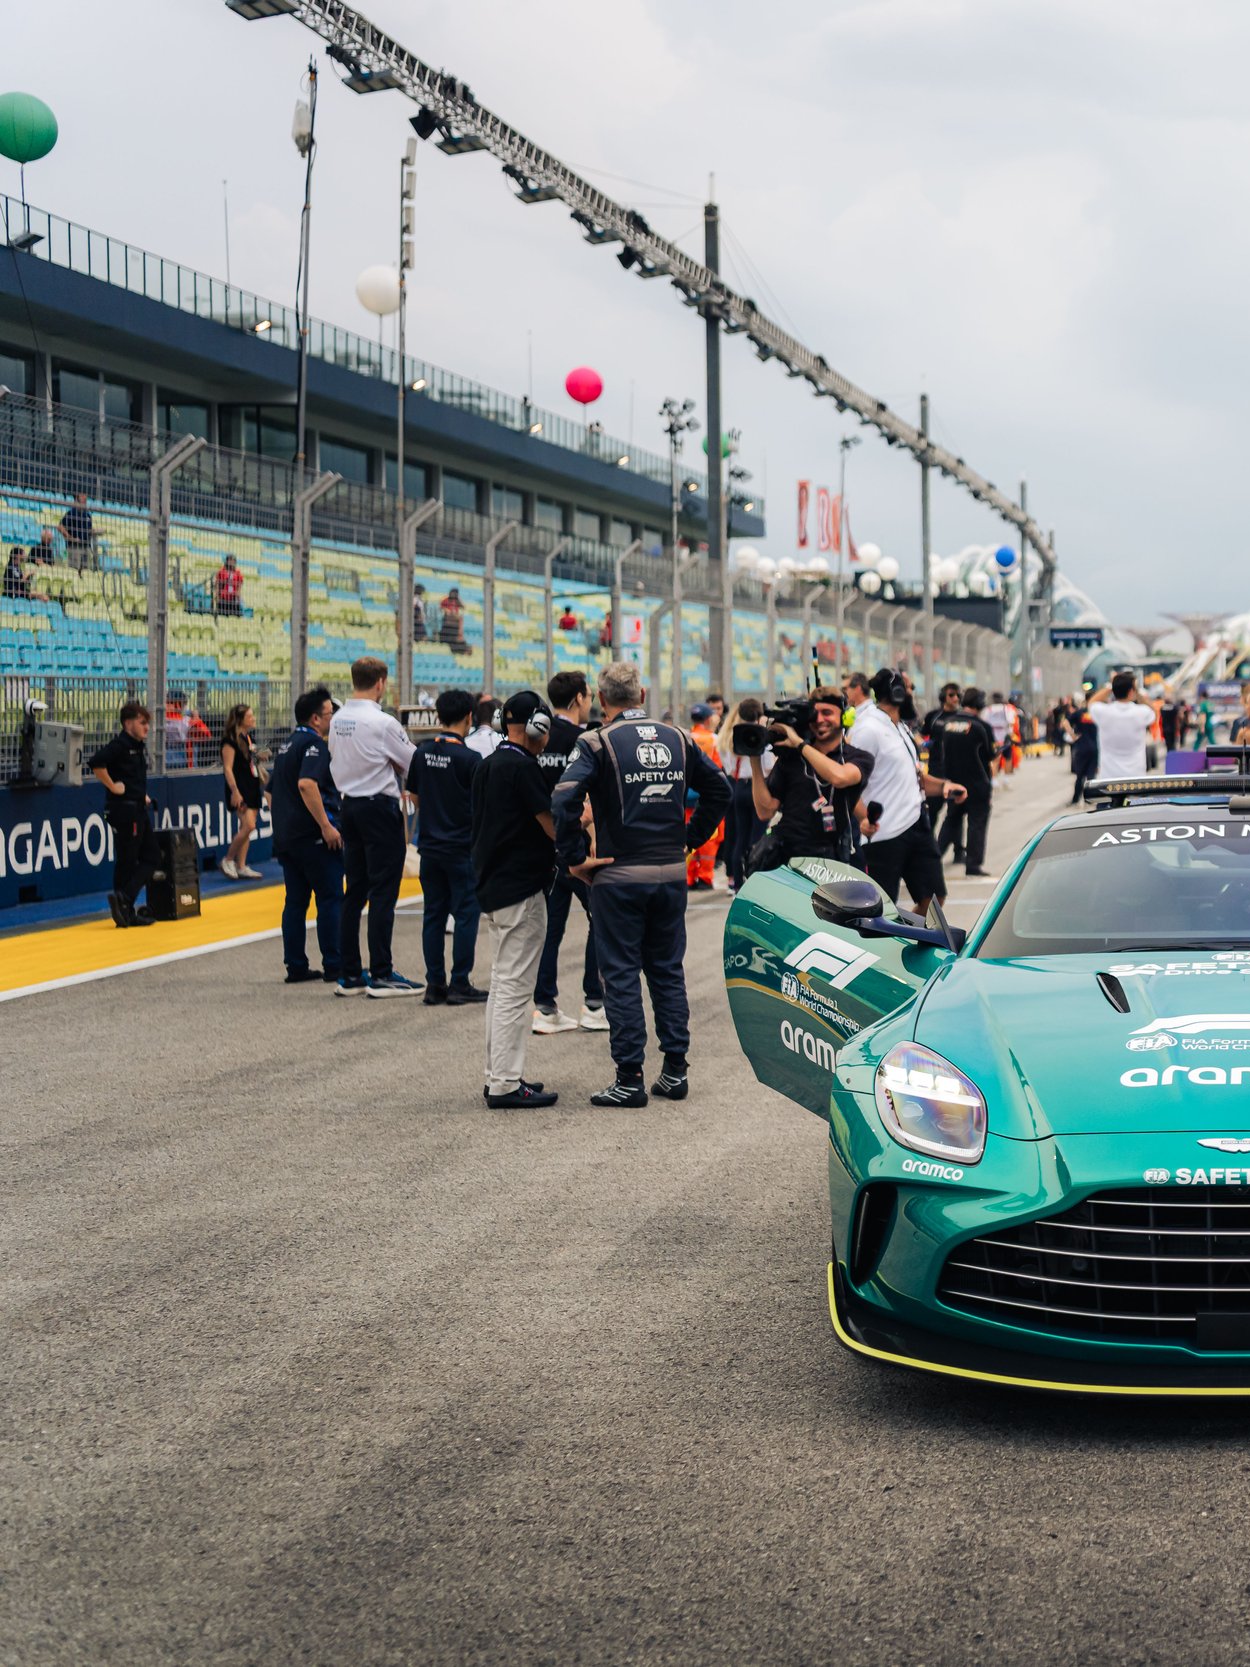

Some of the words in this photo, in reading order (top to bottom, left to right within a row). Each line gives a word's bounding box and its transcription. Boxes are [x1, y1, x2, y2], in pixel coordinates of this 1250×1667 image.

[636, 742, 672, 768] FIA
[625, 771, 665, 783] SAFETY
[667, 771, 684, 780] CAR
[1092, 825, 1225, 848] ASTON
[803, 863, 833, 883] ASTON
[781, 972, 800, 1002] FIA
[800, 984, 810, 998] FIA
[810, 988, 835, 1009] Formula
[800, 995, 817, 1011] World
[780, 1020, 842, 1074] aram
[1125, 1033, 1178, 1052] FIA
[902, 1159, 964, 1181] aramco
[1143, 1168, 1171, 1184] FIA
